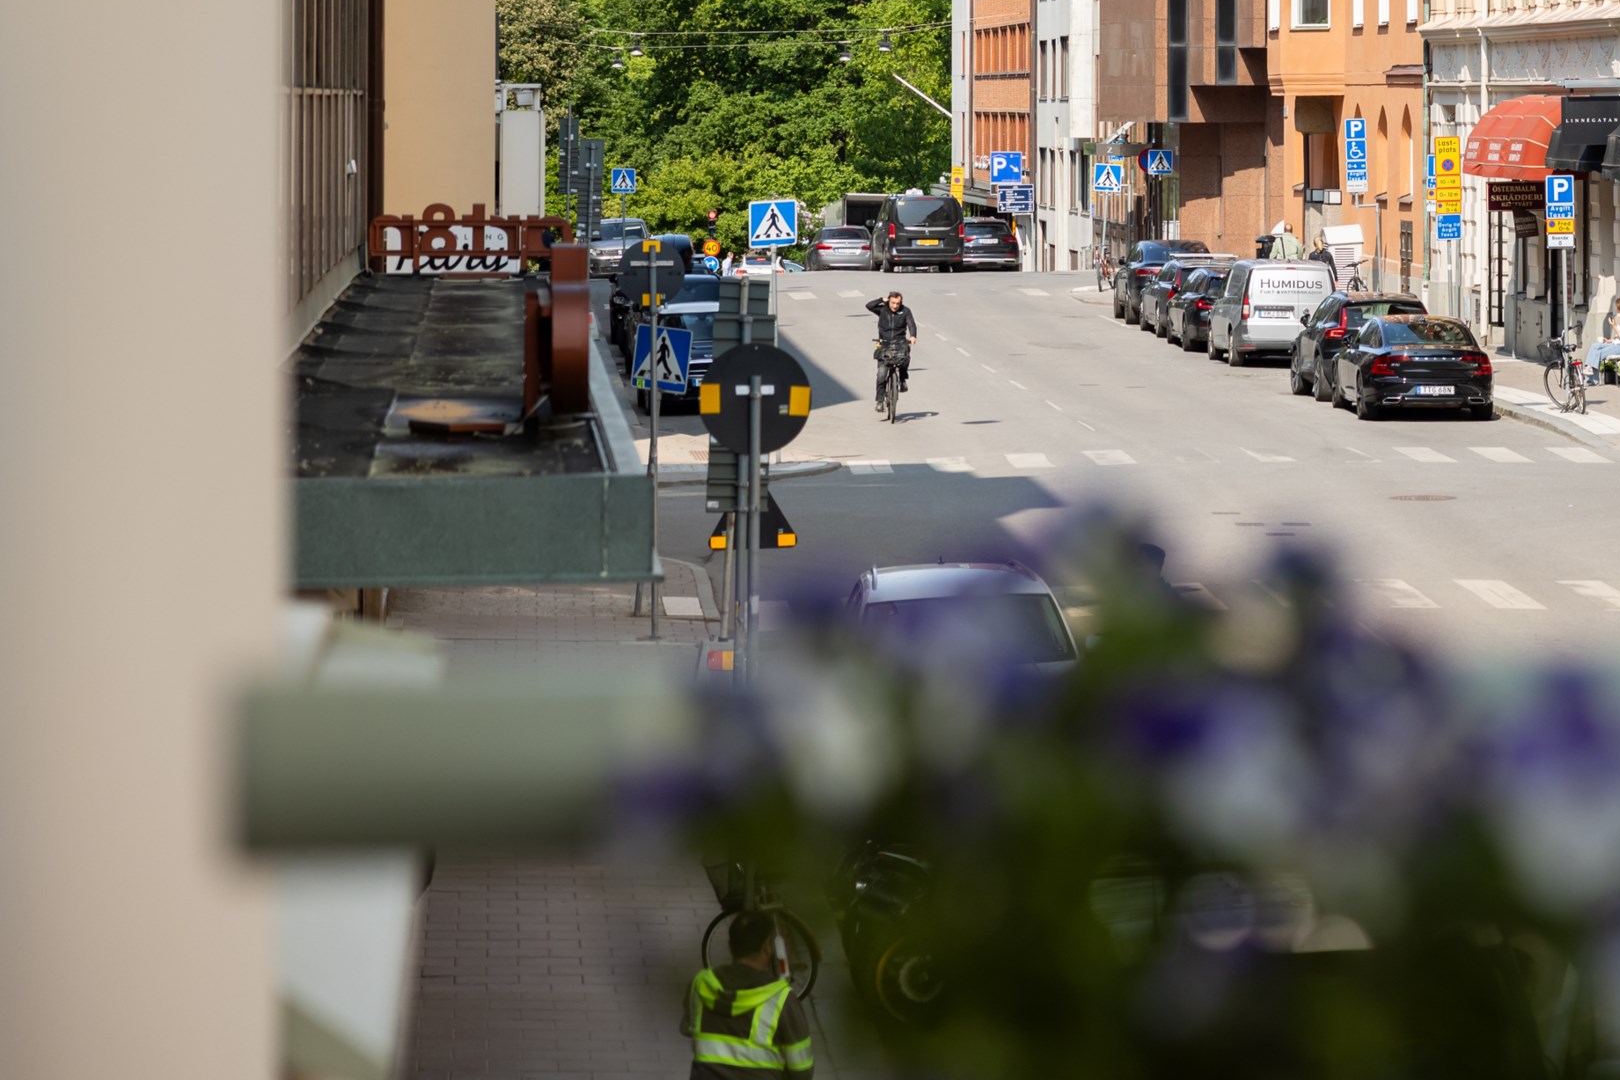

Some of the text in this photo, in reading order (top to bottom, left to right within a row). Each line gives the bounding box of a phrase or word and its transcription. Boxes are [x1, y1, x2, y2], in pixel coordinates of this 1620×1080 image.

[1350, 120, 1363, 138] P
[1438, 139, 1457, 147] Last-
[1438, 146, 1457, 154] plats
[993, 157, 1007, 177] P
[1492, 184, 1537, 192] ÖSTERMALM
[1553, 178, 1569, 201] P
[1490, 193, 1543, 202] SKRÄDDERI
[706, 244, 718, 252] 40
[1260, 278, 1323, 289] HUMIDUS
